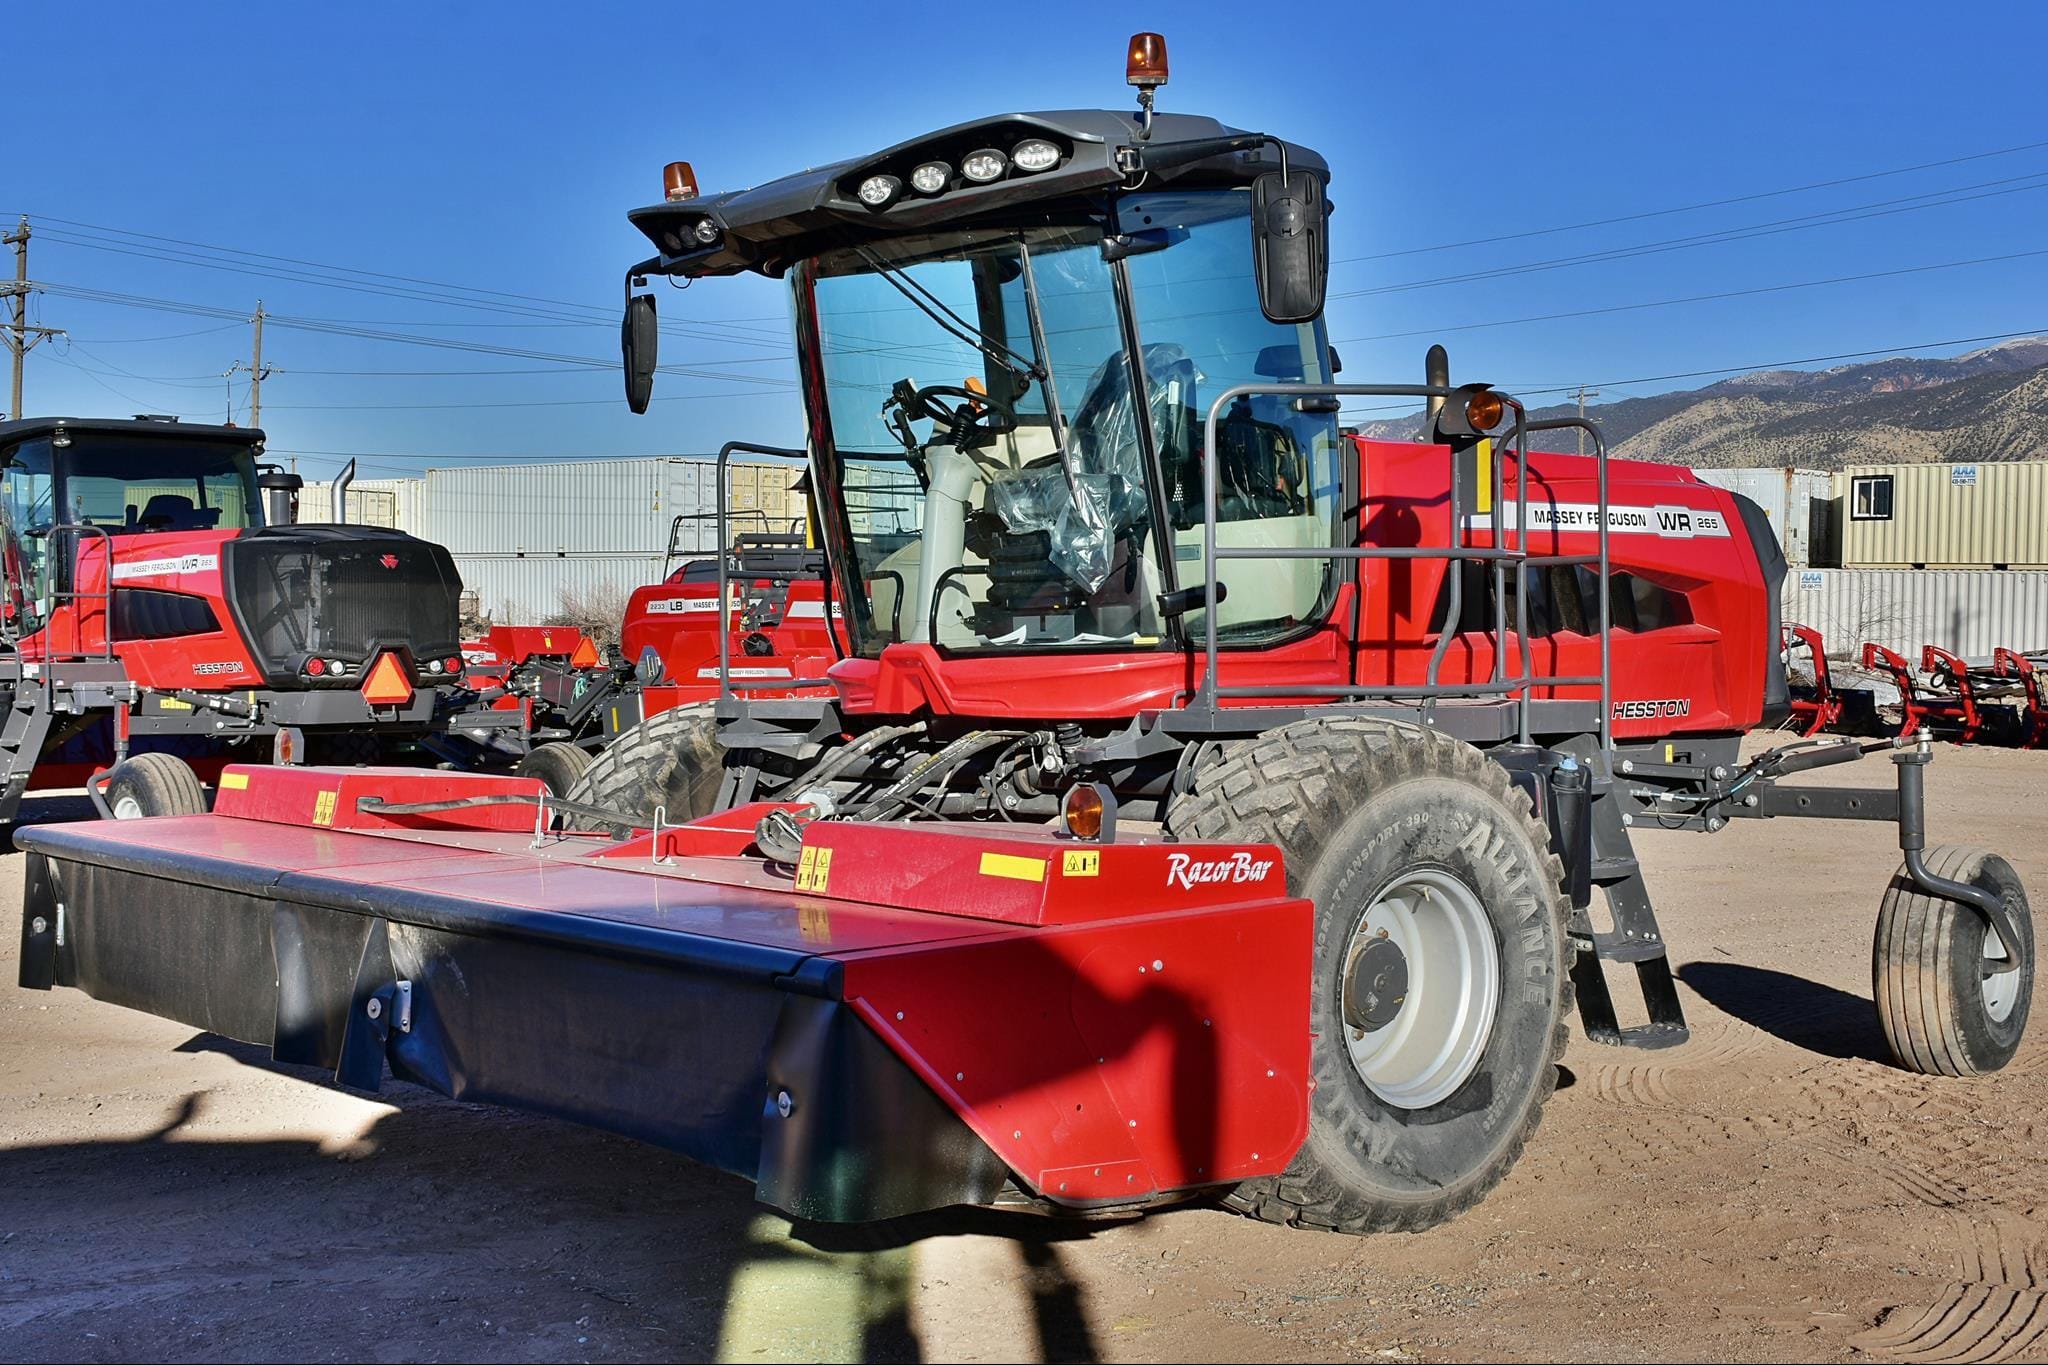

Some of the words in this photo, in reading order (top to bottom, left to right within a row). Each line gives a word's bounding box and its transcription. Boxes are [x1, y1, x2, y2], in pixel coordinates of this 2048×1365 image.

[1534, 509, 1583, 524] MASSEY
[1587, 511, 1647, 527] FEGUSON
[1656, 511, 1692, 531] WR
[1697, 517, 1718, 529] 265
[181, 558, 198, 570] WR
[669, 601, 683, 611] LB
[192, 661, 244, 675] HESSTON
[1611, 699, 1691, 720] HESSTON
[1406, 812, 1429, 828] 390
[1166, 852, 1274, 890] RazorBar
[1456, 818, 1547, 1006] ALLIANCE
